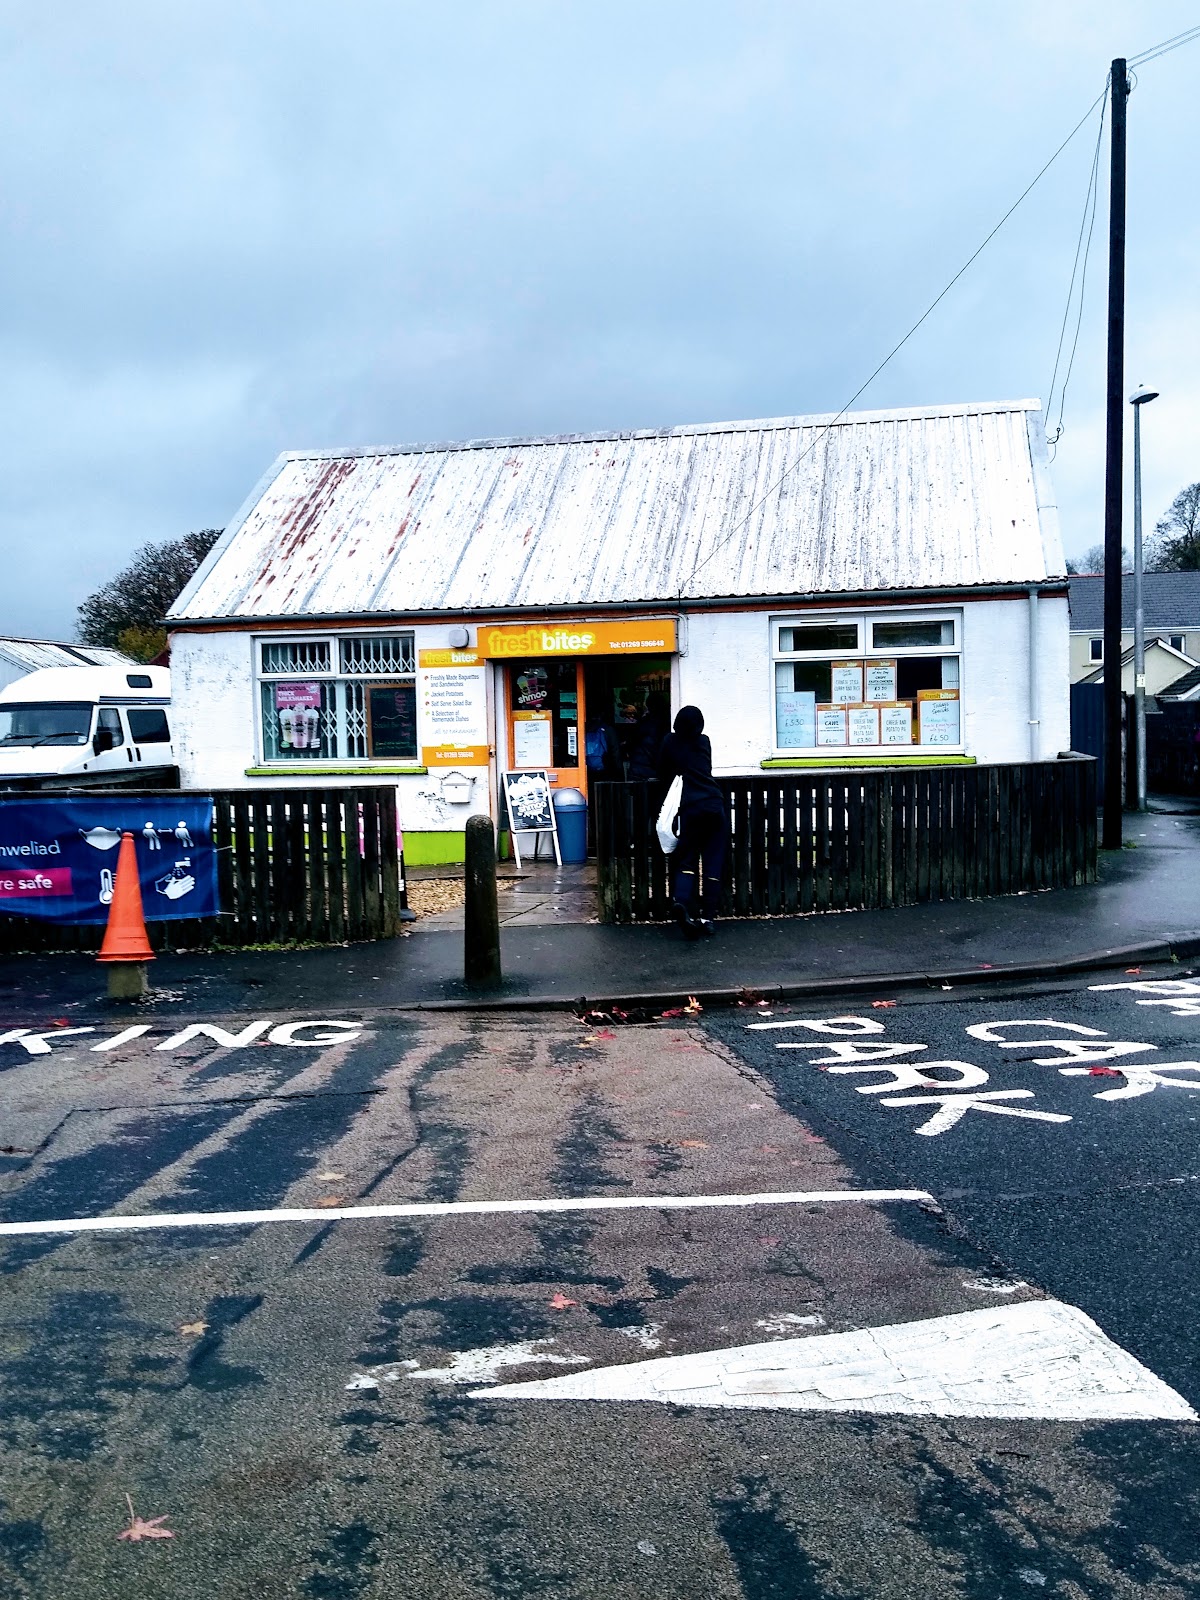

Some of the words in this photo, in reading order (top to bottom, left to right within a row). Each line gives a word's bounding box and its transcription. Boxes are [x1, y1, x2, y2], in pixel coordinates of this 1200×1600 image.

[518, 691, 547, 703] shmoo
[18, 873, 53, 890] safe
[745, 1017, 1073, 1136] PARK
[965, 1019, 1200, 1101] CAR
